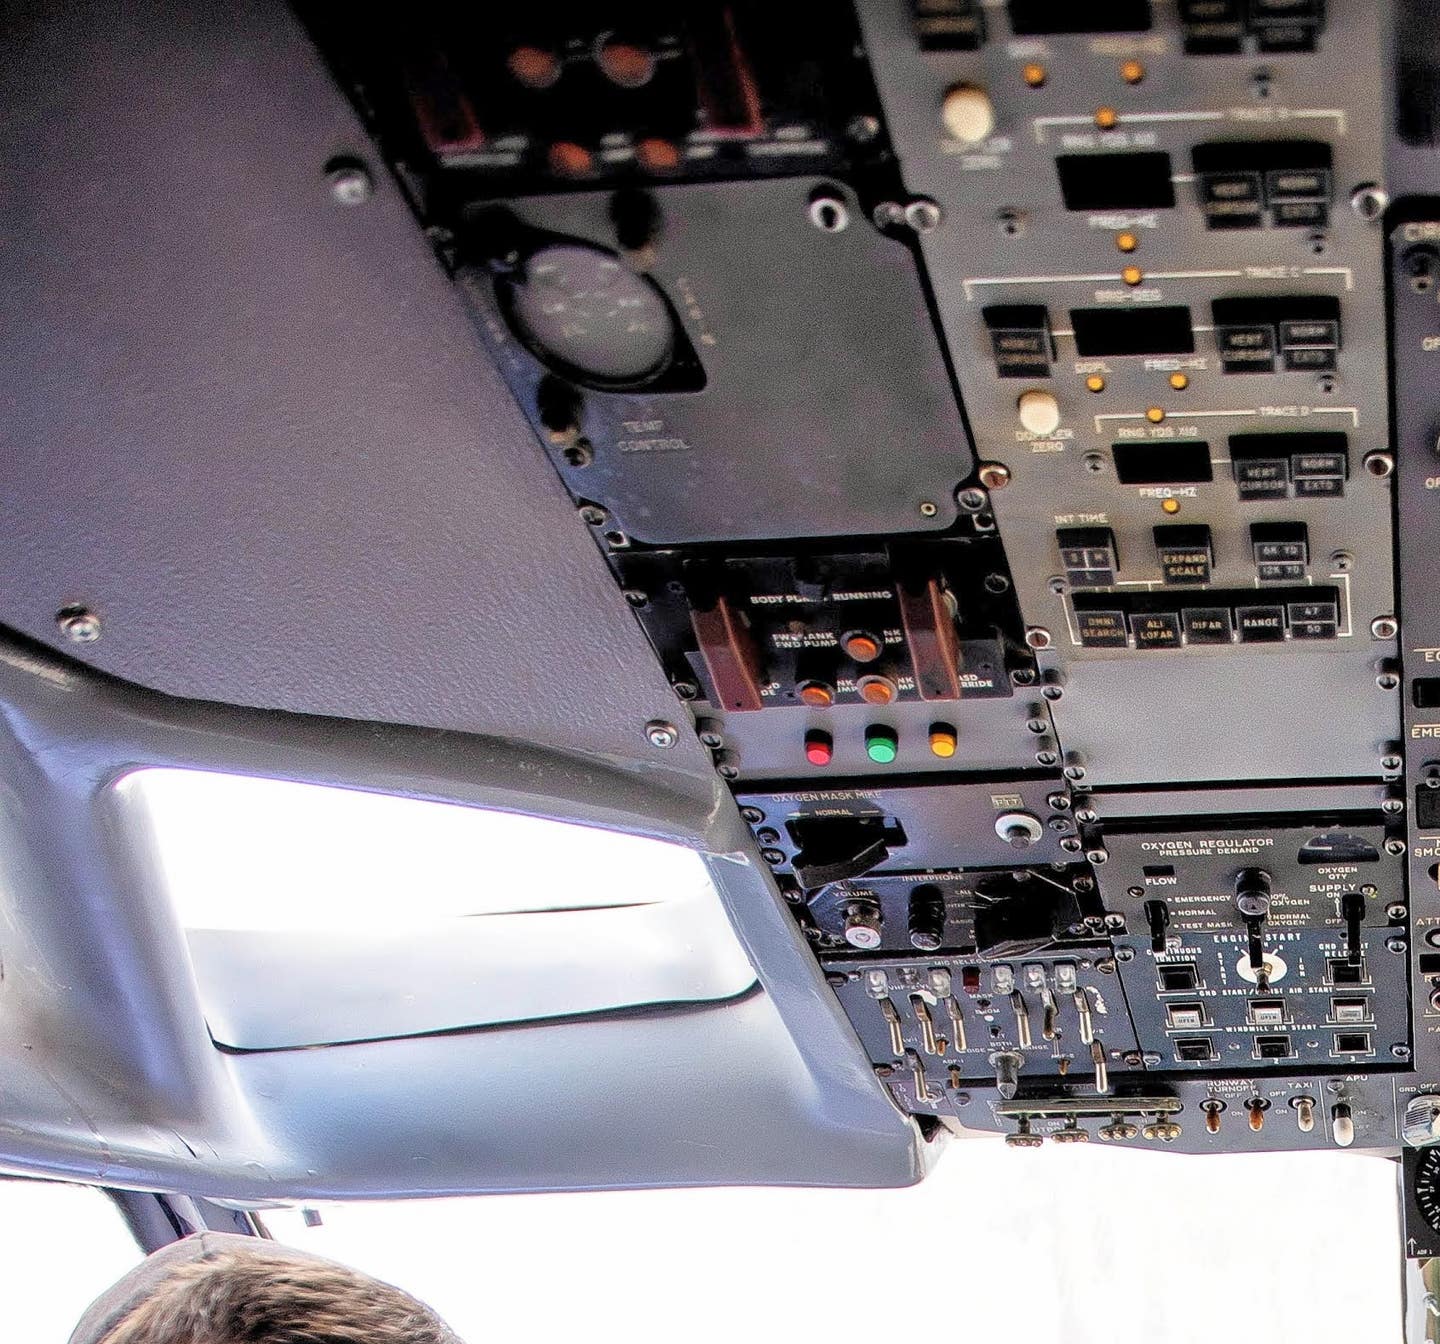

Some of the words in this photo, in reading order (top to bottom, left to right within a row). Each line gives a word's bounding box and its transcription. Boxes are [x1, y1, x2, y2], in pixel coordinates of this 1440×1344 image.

[1078, 513, 1108, 523] TIME
[750, 595, 784, 604] BODY
[832, 591, 892, 601] RUNNING
[1243, 617, 1279, 626] RANGE
[772, 793, 821, 803] OXYGEN
[821, 792, 858, 802] MASK
[859, 791, 883, 800] MIKE
[815, 808, 853, 817] NORMAL
[1141, 841, 1193, 851] OXYGEN
[1199, 838, 1275, 848] REGULATOR
[1159, 848, 1214, 856] PRESSURE
[1217, 846, 1260, 854] DEMAND
[1318, 866, 1359, 875] OXYGEN
[901, 874, 965, 883] INTERPHONE
[1145, 877, 1178, 886] FLOW
[1328, 873, 1348, 881] QTY
[1309, 883, 1357, 893] SUPPLY
[832, 890, 875, 898] VOLUME
[1326, 891, 1341, 899] ON
[1175, 895, 1232, 903] EMERGENCY
[1271, 898, 1311, 906] OXYGEN
[1274, 913, 1311, 921] NORMAL
[1267, 919, 1306, 927] OXYGEN
[1266, 934, 1302, 942] START
[1225, 1024, 1270, 1032] WINDMILL
[1345, 1074, 1369, 1082] APU
[1207, 1079, 1255, 1087] RUNWAY
[1287, 1081, 1313, 1090] TAXI
[1206, 1085, 1258, 1094] TURNOFF
